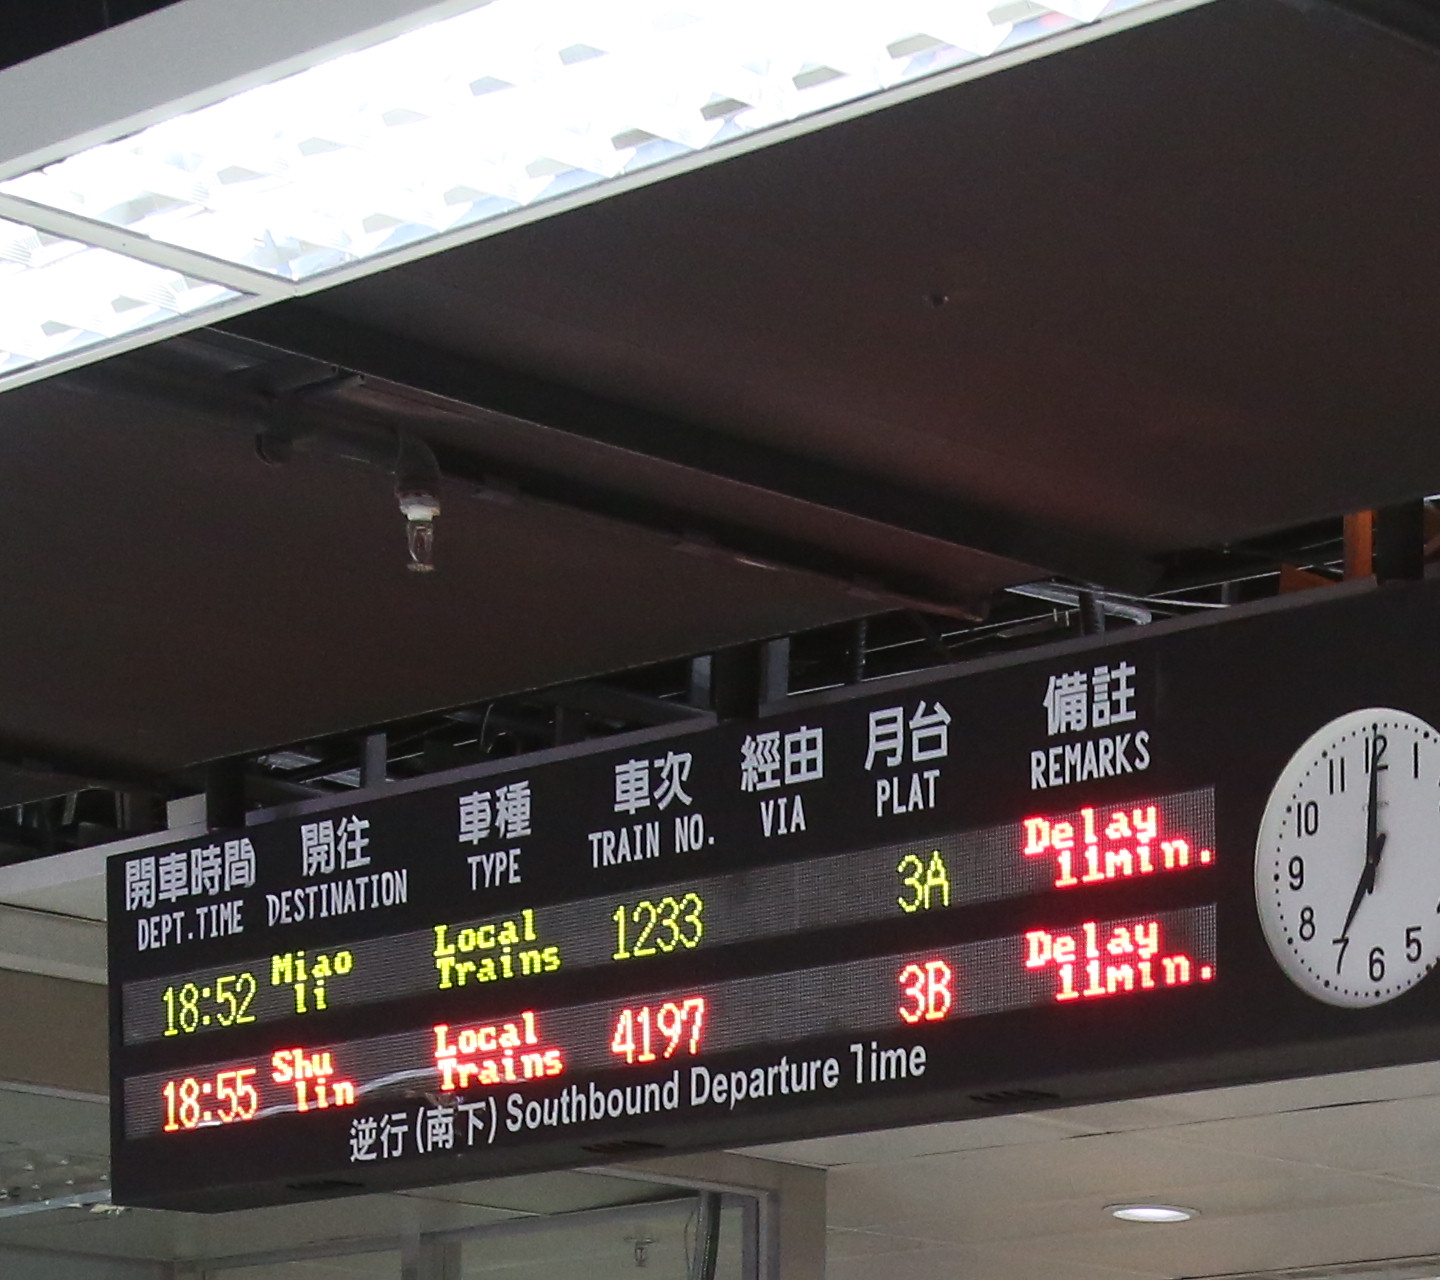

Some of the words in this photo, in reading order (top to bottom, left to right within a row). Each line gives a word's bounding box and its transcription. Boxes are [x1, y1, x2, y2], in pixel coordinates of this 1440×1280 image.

[1043, 661, 1136, 735] 備註
[741, 725, 824, 791] 經由
[865, 701, 952, 770] 月台
[1030, 730, 1151, 790] REMARKS
[613, 751, 693, 815] 車次
[876, 769, 940, 817] PLAT
[1328, 756, 1346, 794] 11
[458, 781, 531, 845] 車種
[760, 795, 806, 837] VIA
[1024, 804, 1156, 856] Delay
[1296, 800, 1320, 838] 10
[301, 816, 371, 876] 開往
[588, 820, 659, 868] TRAIN
[674, 813, 715, 853] NO.
[1054, 835, 1215, 888] 11min.
[125, 838, 255, 912] 開車時間
[467, 850, 522, 890] TYPE
[897, 850, 950, 913] 3A
[1288, 856, 1306, 891] 9
[267, 869, 408, 927] DESTINATION
[1298, 906, 1316, 941] 8
[137, 901, 244, 951] DEPT.TIME
[434, 909, 537, 957] Local
[613, 892, 704, 961] 1233
[1024, 920, 1159, 970] Delay
[1405, 925, 1423, 963] 5
[271, 951, 353, 986] Miao
[436, 942, 560, 989] Trains
[1054, 950, 1215, 1003] 11min.
[1332, 938, 1349, 974] 7
[1368, 946, 1386, 982] 6
[162, 973, 256, 1036] 18:52
[294, 981, 327, 1014] li
[898, 959, 953, 1024] 3B
[434, 1011, 538, 1059] Local
[611, 998, 706, 1065] 4197
[271, 1048, 333, 1083] Shu
[437, 1046, 562, 1091] Trains
[506, 1075, 683, 1134] Southbound
[690, 1054, 839, 1110] Departure
[850, 1042, 927, 1086] Time
[162, 1068, 257, 1133] 18:55
[295, 1077, 355, 1113] lin
